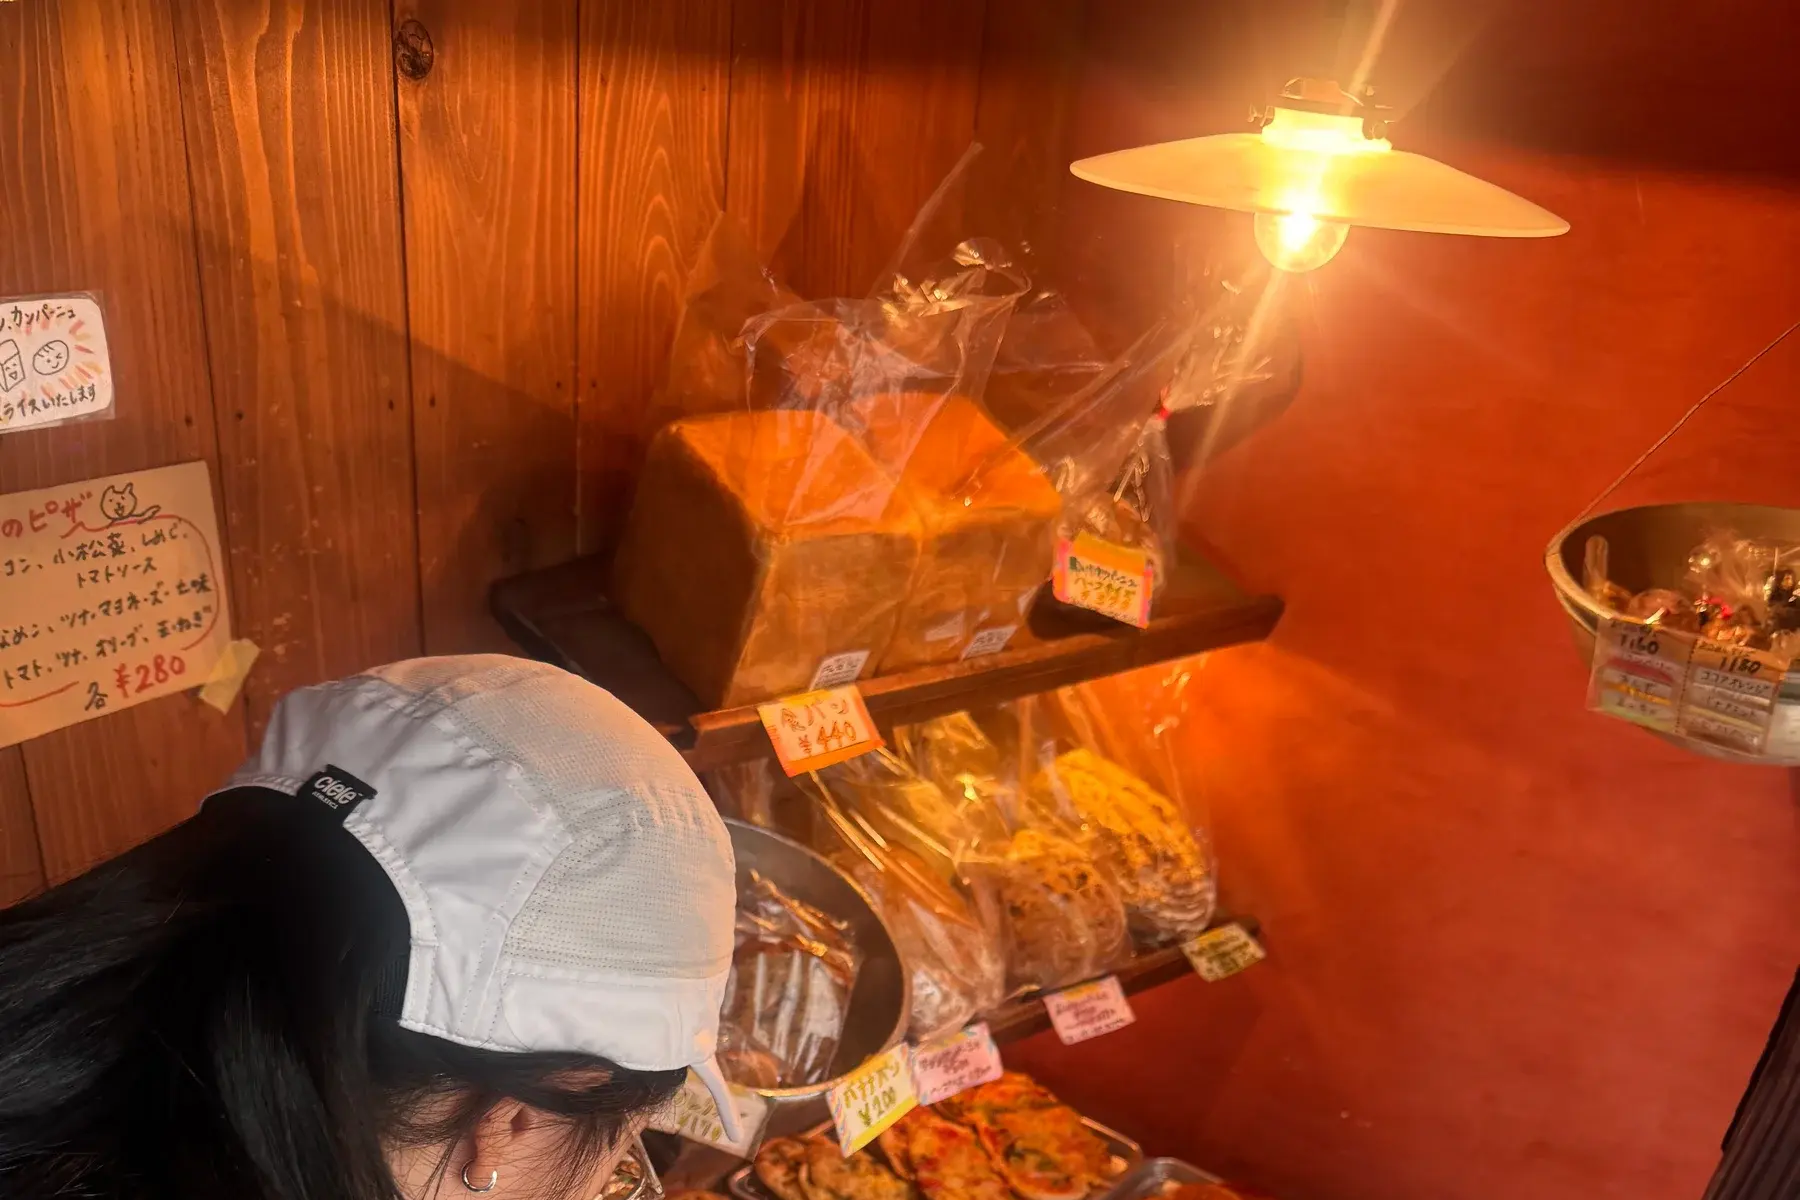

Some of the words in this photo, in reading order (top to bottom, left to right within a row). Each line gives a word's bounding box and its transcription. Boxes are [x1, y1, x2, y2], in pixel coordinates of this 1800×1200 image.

[0, 383, 96, 420] ライスいたします
[77, 557, 157, 589] トマトソース
[113, 653, 187, 699] ¥280
[798, 721, 857, 758] ¥440
